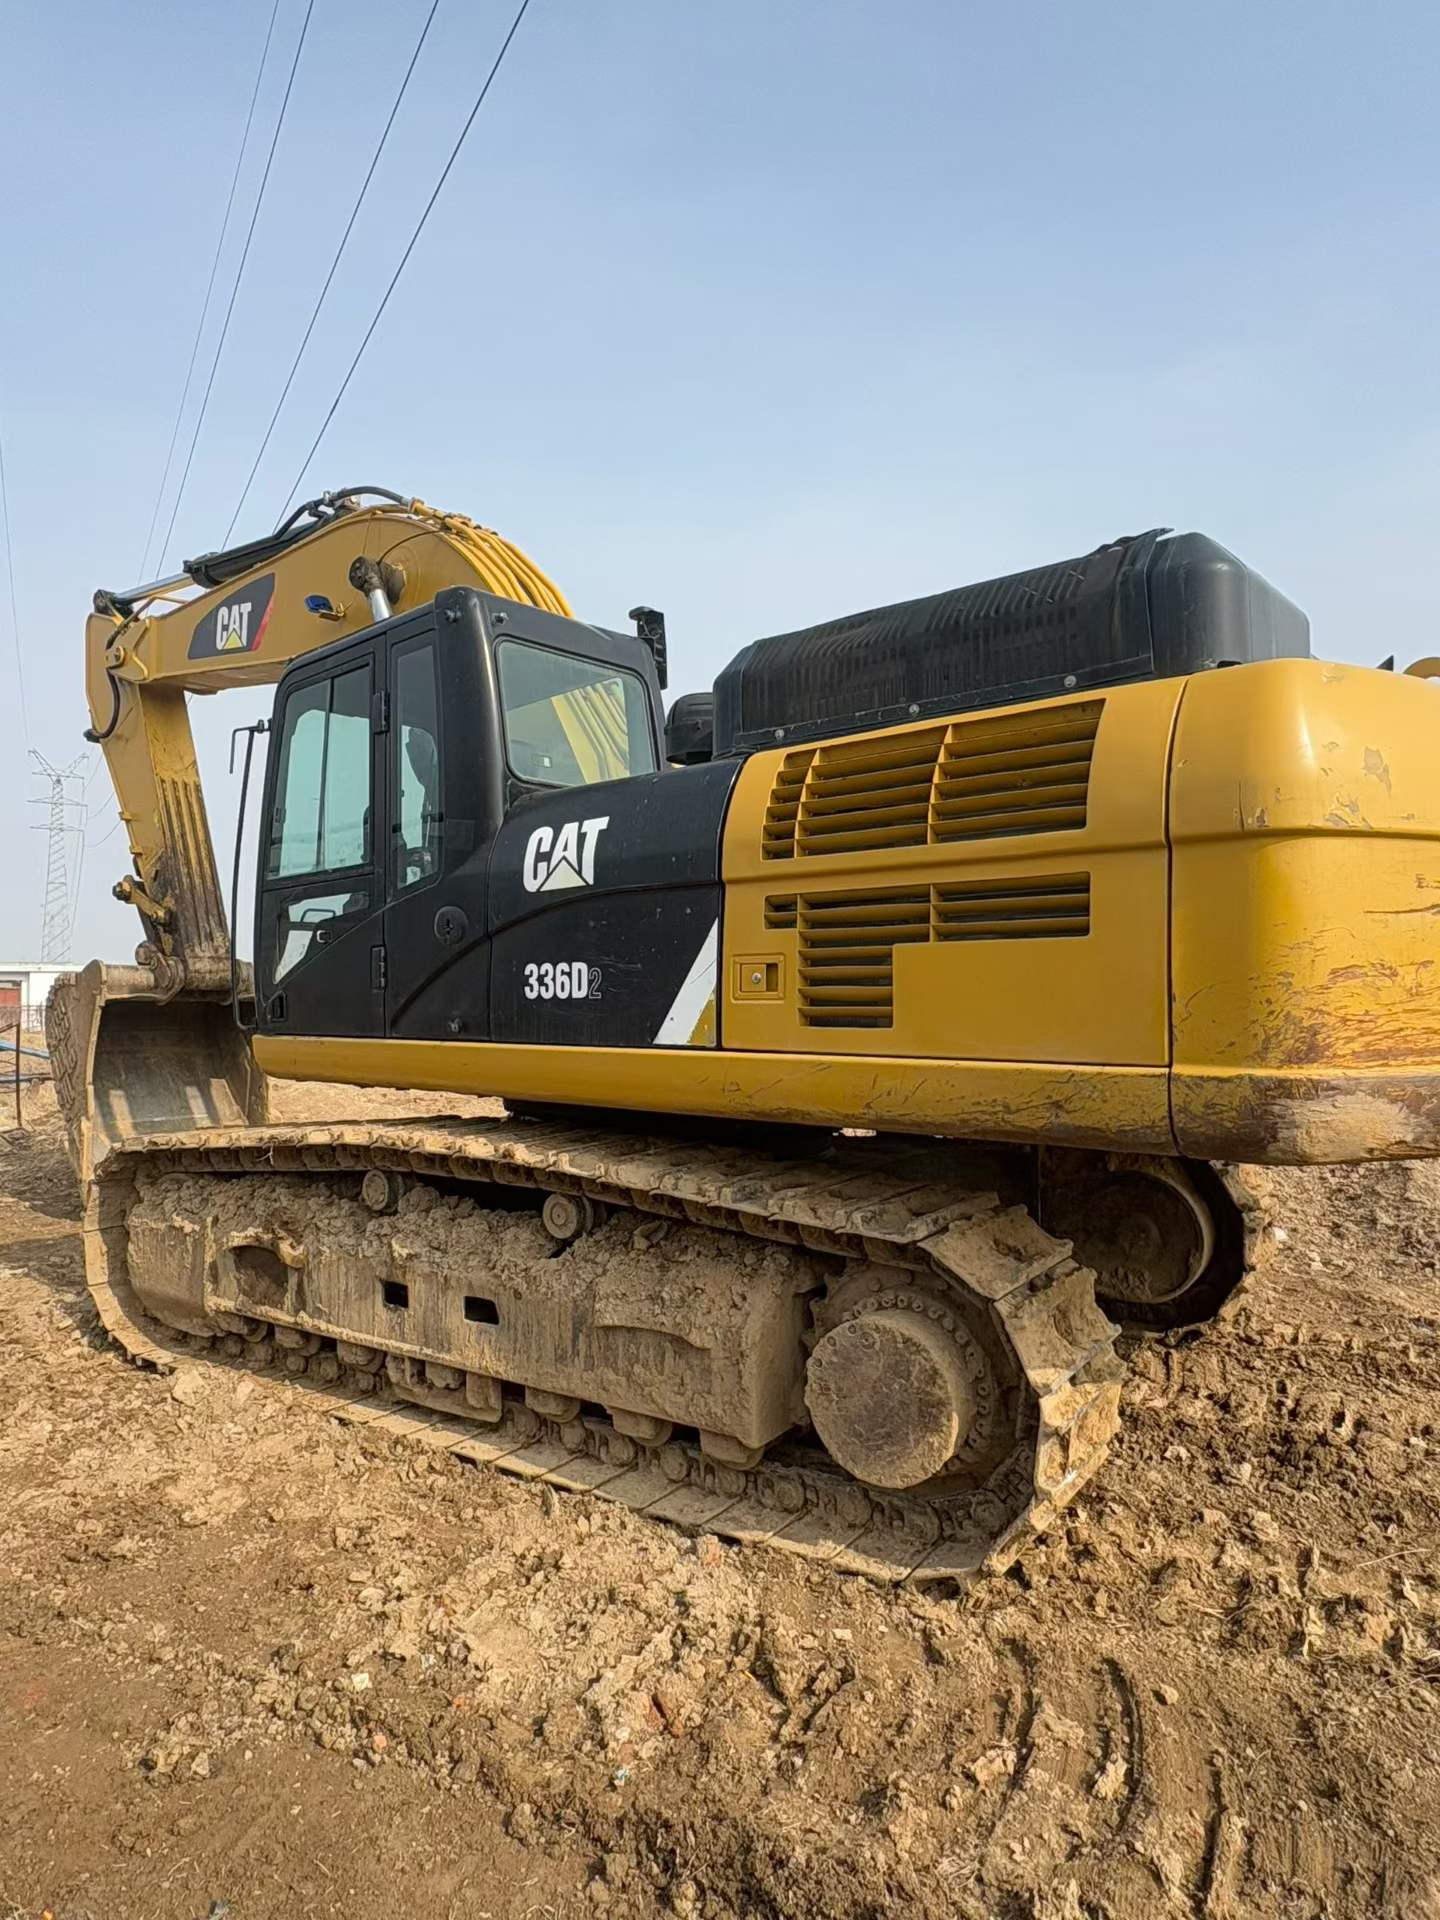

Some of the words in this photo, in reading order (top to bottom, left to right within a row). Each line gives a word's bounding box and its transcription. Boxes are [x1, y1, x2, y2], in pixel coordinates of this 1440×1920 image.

[216, 602, 252, 650] CAT
[523, 816, 610, 893] CAT
[524, 961, 602, 999] 336D2
